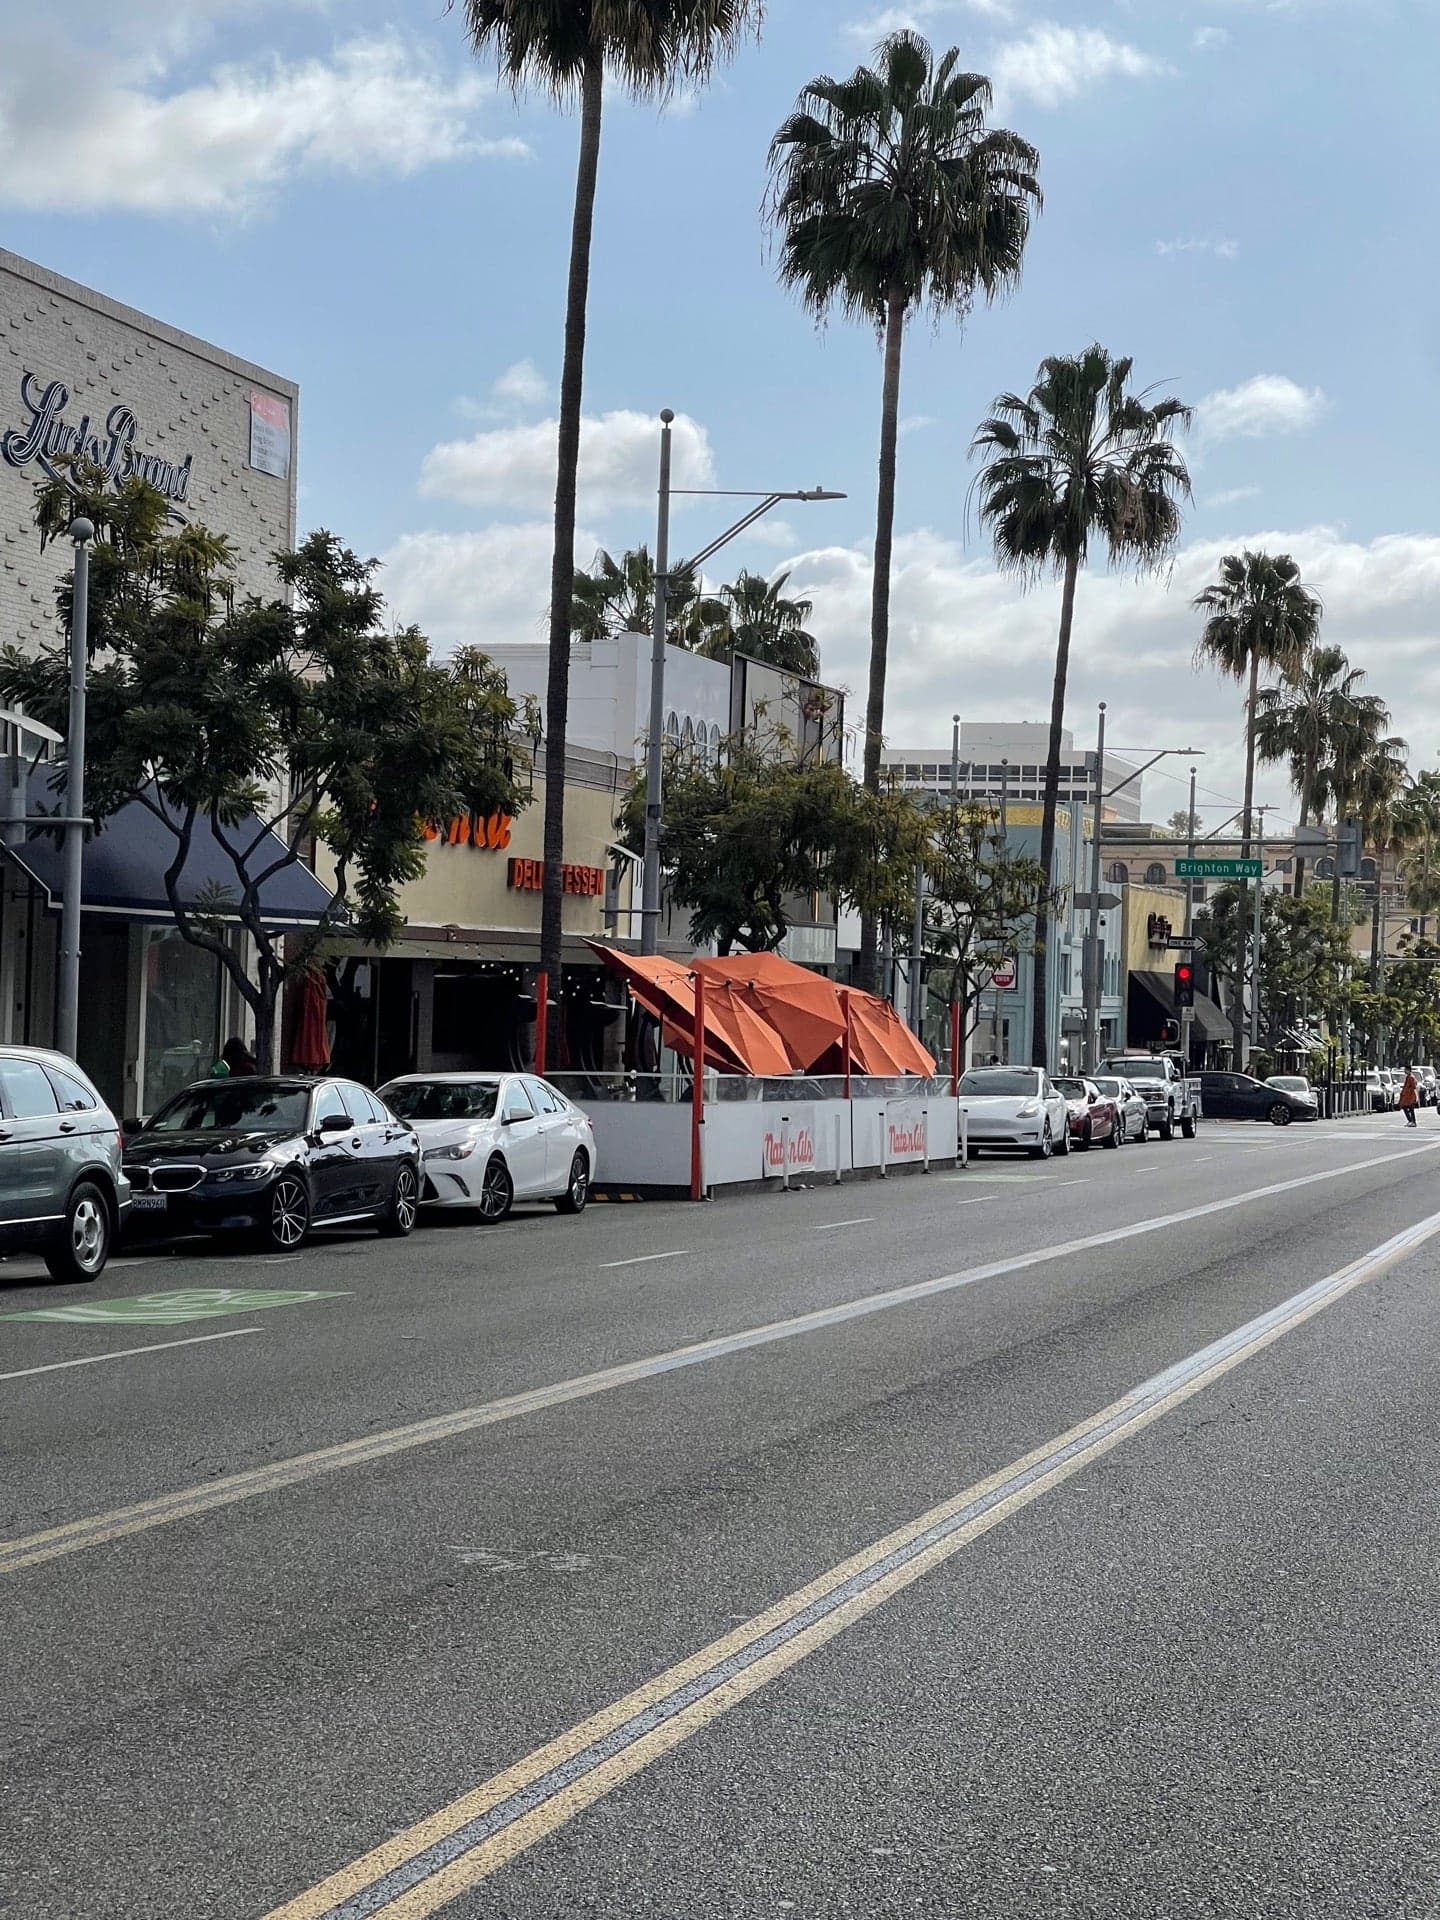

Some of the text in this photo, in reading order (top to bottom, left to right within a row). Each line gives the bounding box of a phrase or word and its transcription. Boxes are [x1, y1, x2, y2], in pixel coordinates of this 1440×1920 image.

[2, 372, 112, 497] Lucky
[106, 404, 193, 502] Brand
[508, 857, 605, 896] DELITESSEN
[1180, 863, 1257, 875] Brighton Way
[764, 1132, 785, 1166] Nat
